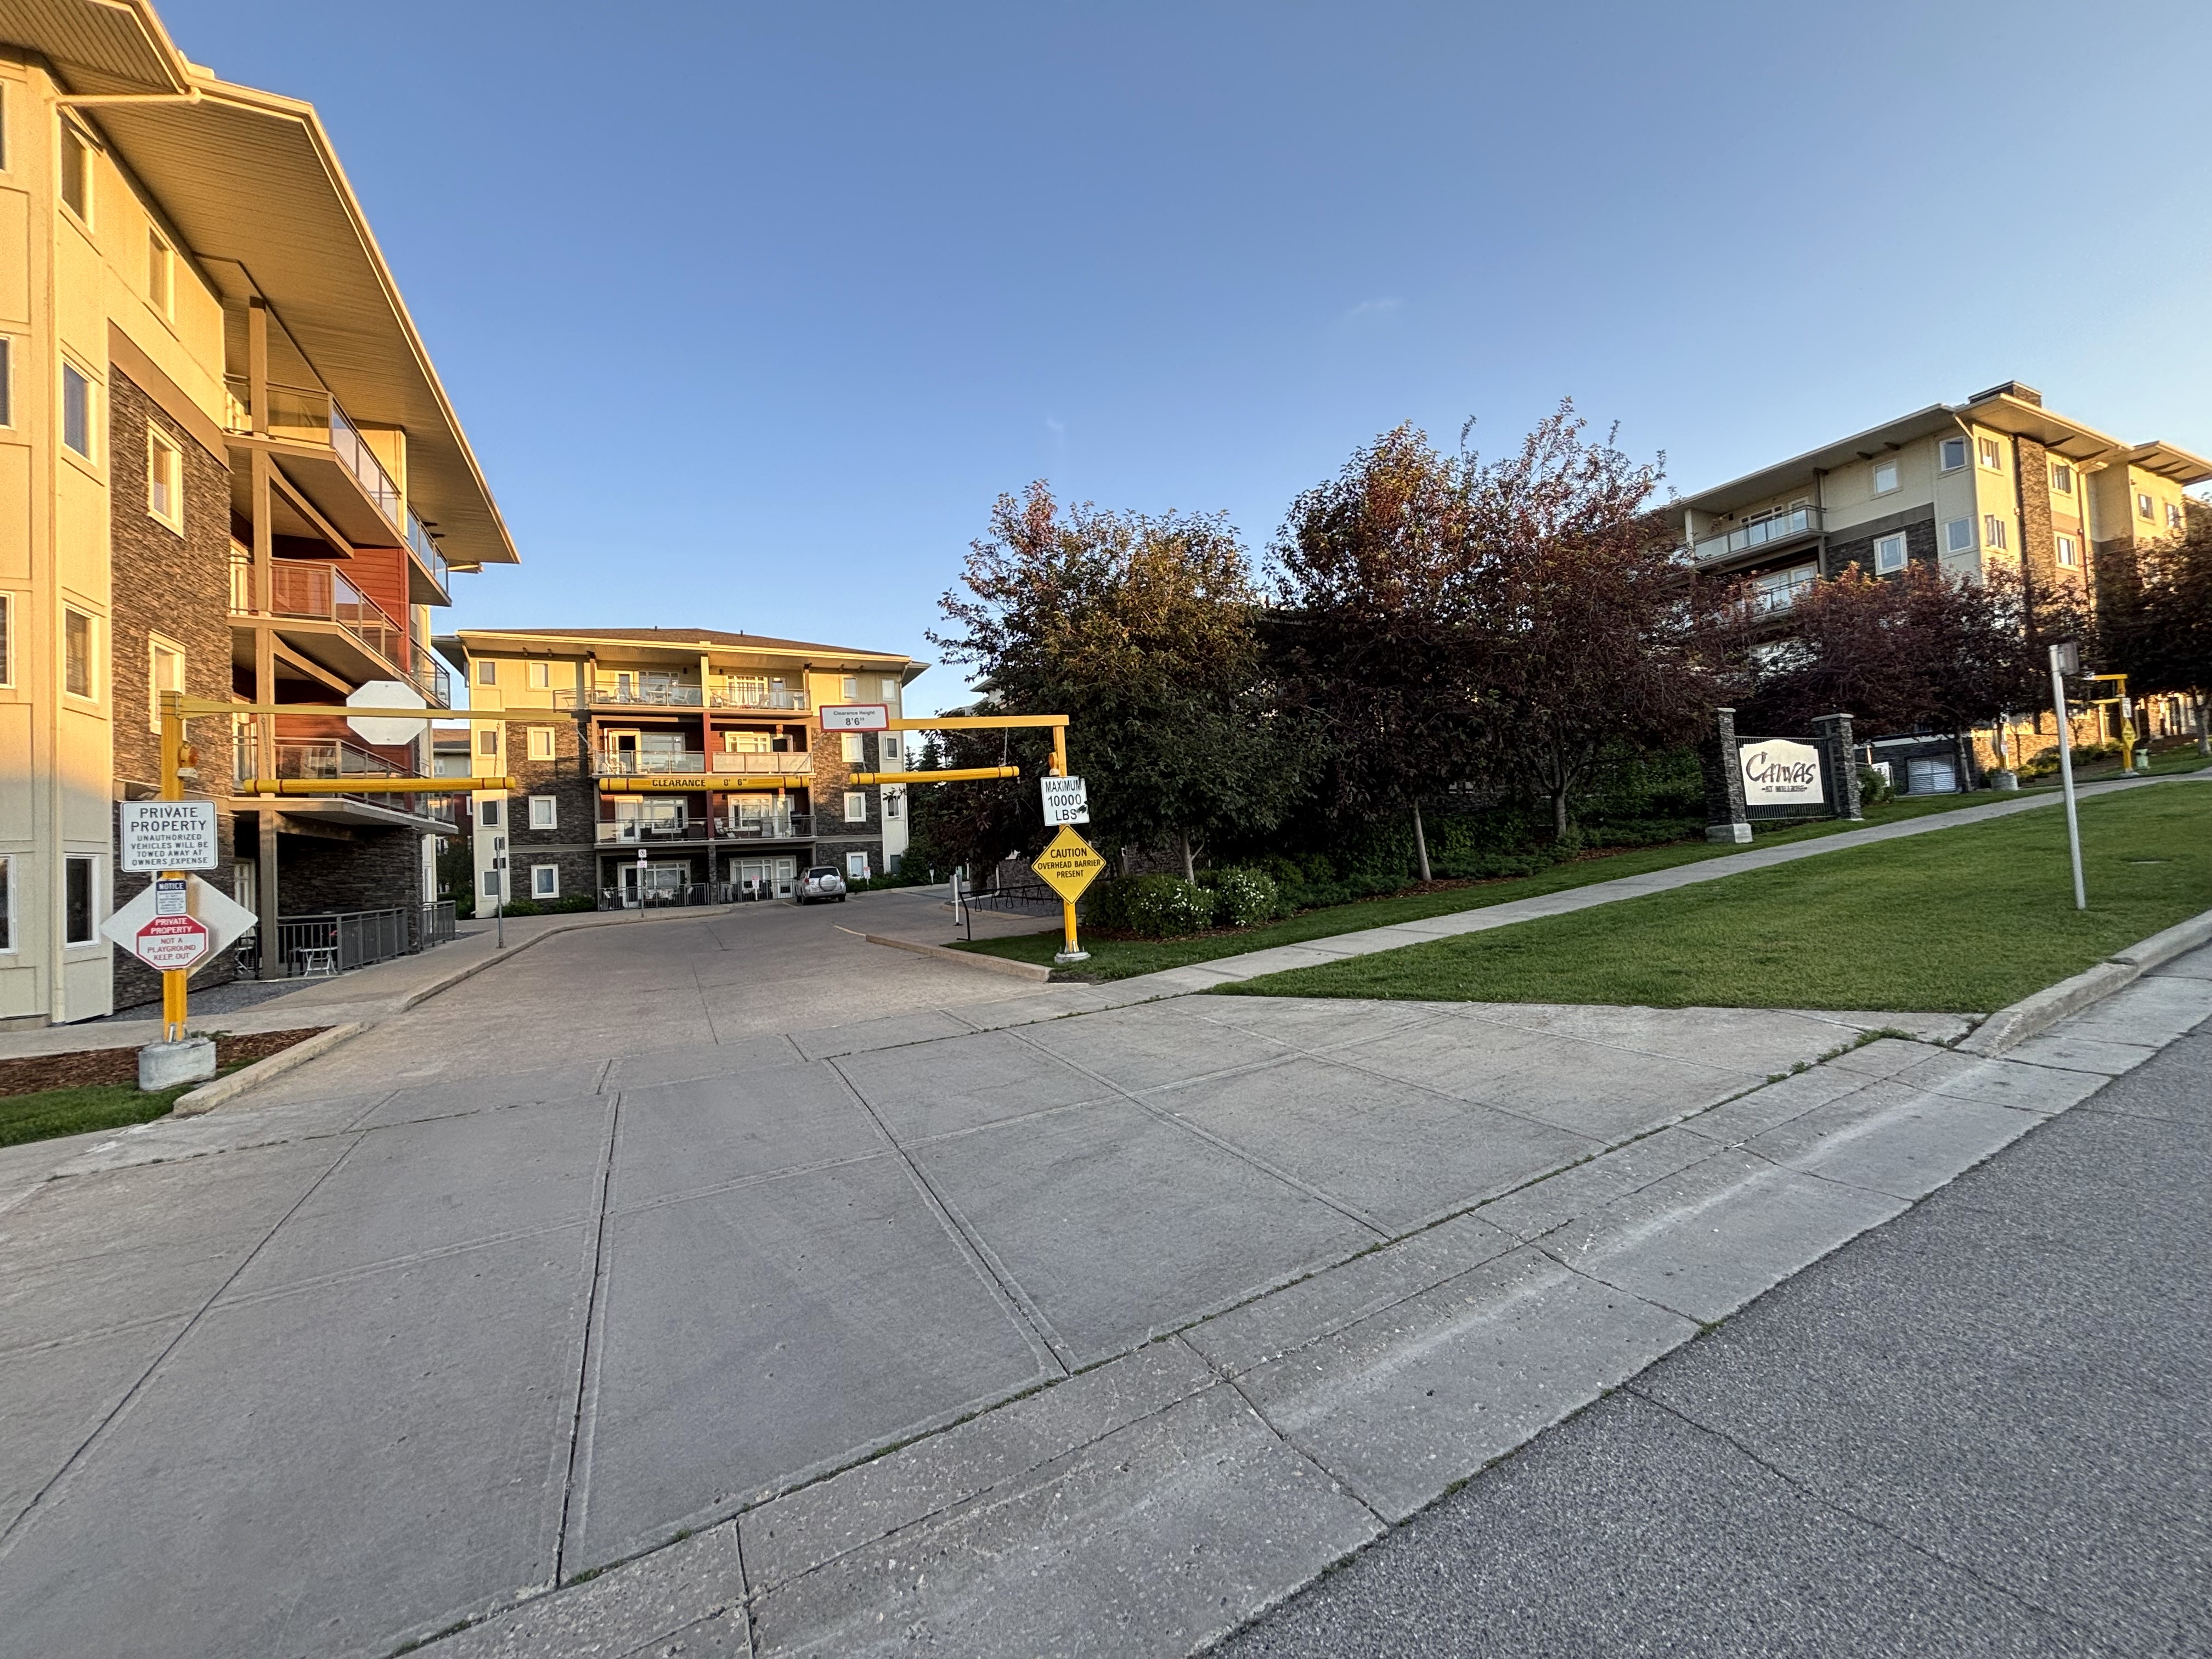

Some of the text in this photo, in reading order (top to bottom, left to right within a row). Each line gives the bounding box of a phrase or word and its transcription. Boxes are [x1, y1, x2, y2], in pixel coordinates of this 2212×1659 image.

[1045, 779, 1082, 793] MAXIMUM
[1048, 794, 1082, 807] 10000
[140, 807, 198, 818] PRIVATE
[1055, 809, 1077, 821] LBS
[131, 820, 206, 832] PROPERTY
[1050, 848, 1087, 859] CAUTION
[1037, 859, 1101, 870] OVERHEAD BARRIER
[1057, 870, 1084, 878] PRESENT
[155, 918, 188, 926] PRIVATE
[150, 926, 193, 935] PROPERTY
[147, 945, 196, 953] PLAYGROUND
